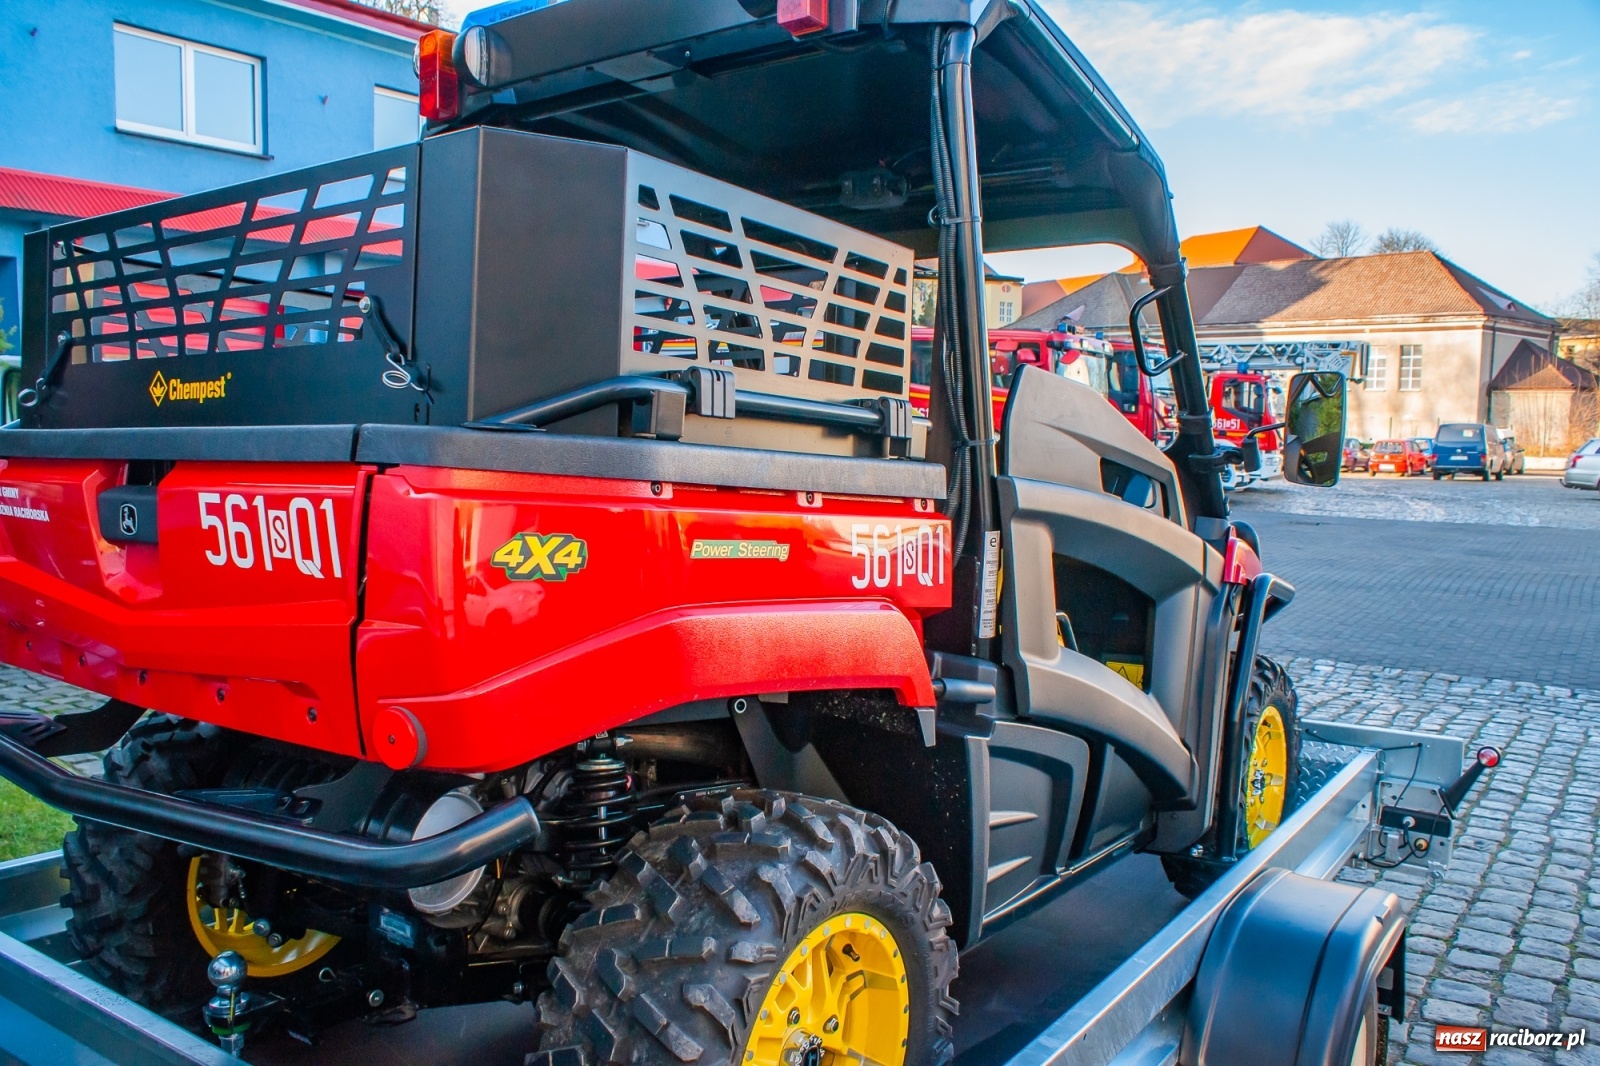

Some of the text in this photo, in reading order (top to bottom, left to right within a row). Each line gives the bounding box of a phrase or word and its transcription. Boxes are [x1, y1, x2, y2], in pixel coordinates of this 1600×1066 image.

[168, 375, 226, 404] Chempest
[13, 506, 49, 522] RACIBORSKA
[493, 535, 583, 575] 4X4
[691, 541, 789, 561] Power Steering
